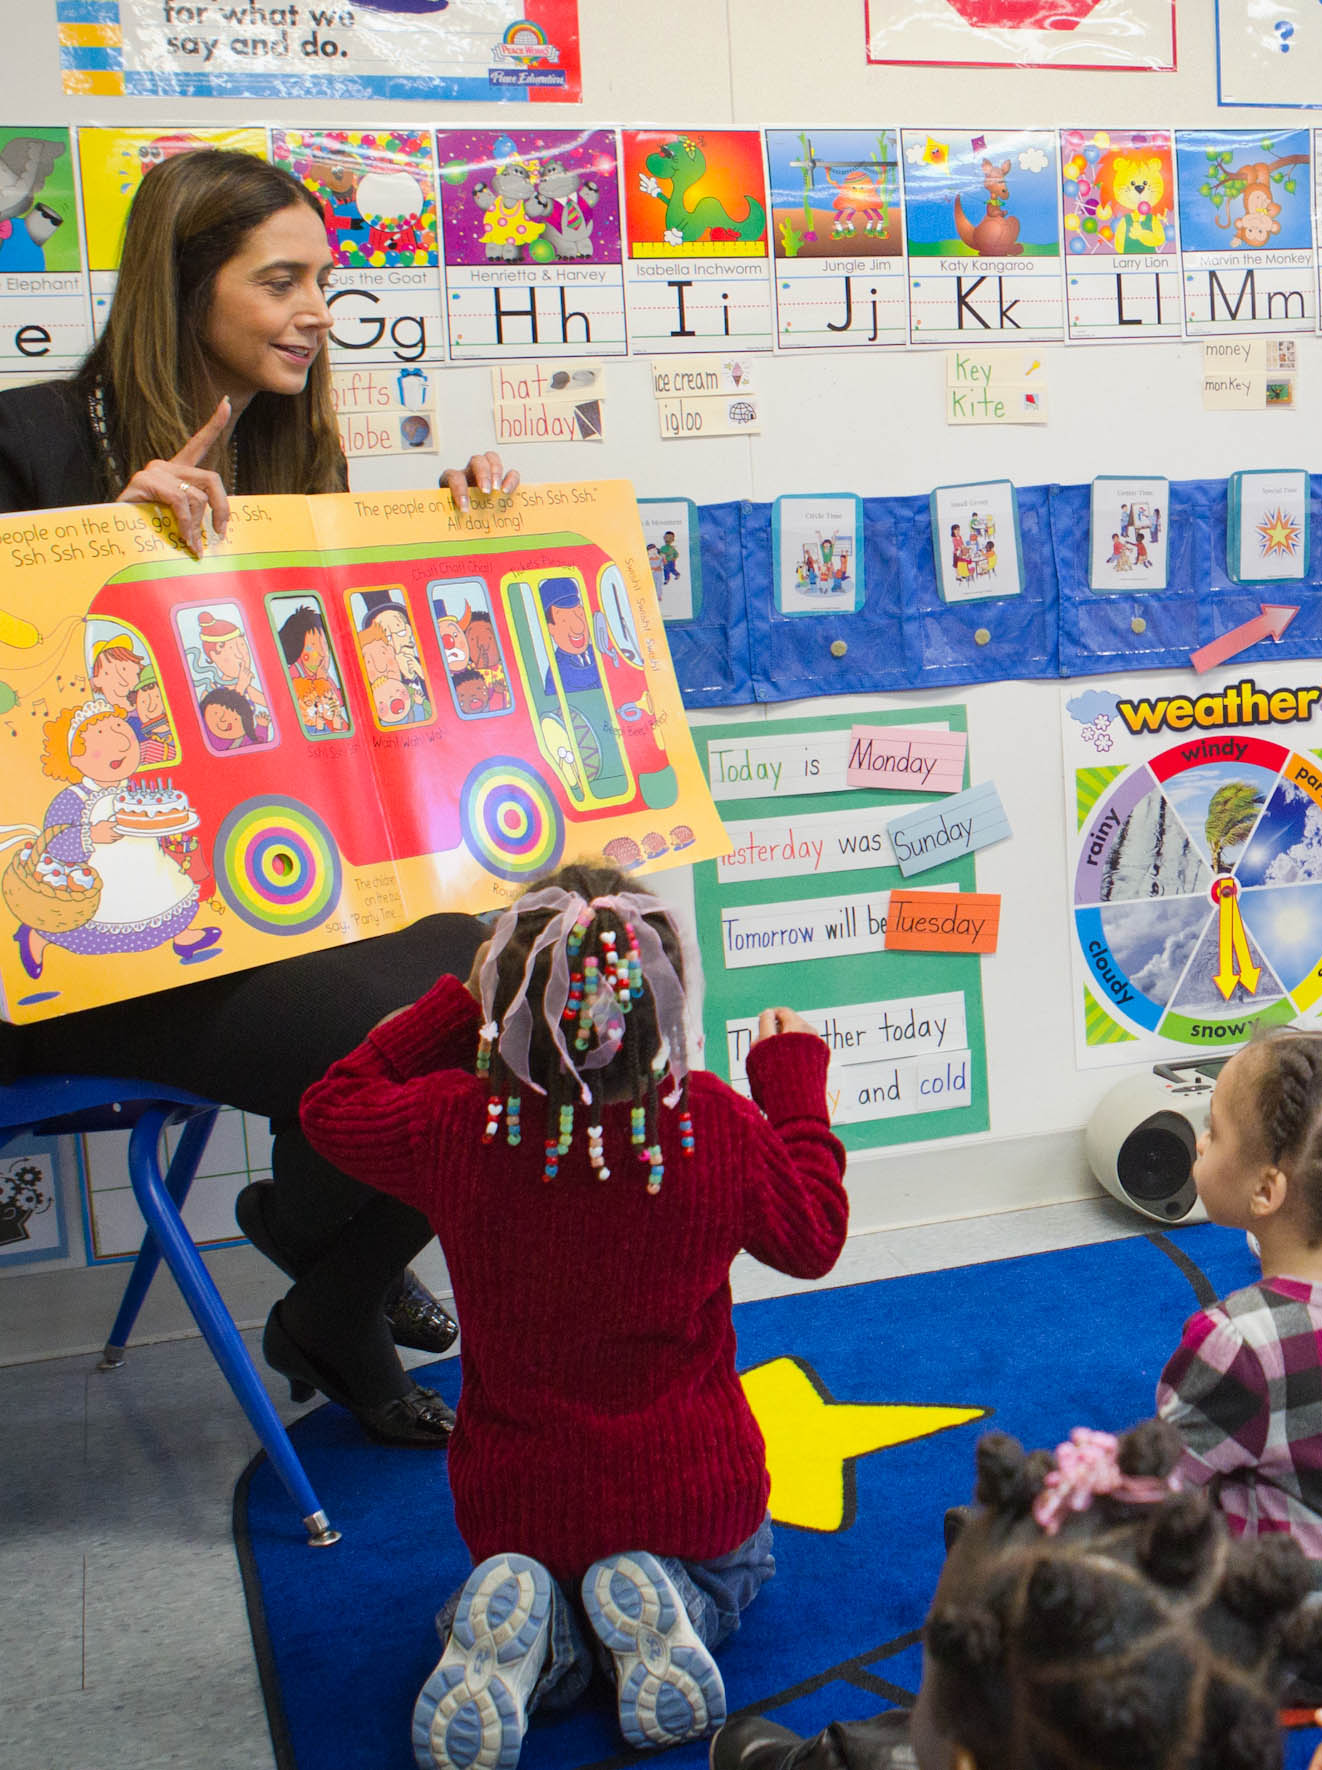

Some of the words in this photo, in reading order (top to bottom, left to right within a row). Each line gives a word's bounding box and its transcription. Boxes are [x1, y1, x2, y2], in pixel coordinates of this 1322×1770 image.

[163, 0, 208, 25] for
[219, 0, 298, 27] what
[308, 7, 356, 28] we
[167, 37, 219, 62] say
[229, 32, 289, 58] and
[300, 32, 349, 59] do.
[636, 263, 690, 276] Isabella
[693, 262, 762, 276] Inchworm
[822, 260, 866, 274] Jungle
[869, 259, 891, 272] Jim
[940, 260, 969, 274] Katy
[972, 259, 1034, 274] Kangaroo
[1113, 256, 1142, 271] Larry
[1145, 256, 1169, 269] Lion
[1242, 252, 1262, 266] the
[1265, 252, 1312, 267] Monkey
[6, 277, 80, 293] Elephant
[329, 272, 356, 286] Gus
[359, 271, 384, 285] the
[386, 271, 428, 285] Goat
[470, 268, 538, 282] Henrietta
[541, 269, 552, 281] &
[556, 269, 607, 284] Harvey
[1205, 343, 1251, 363] money
[499, 364, 549, 401] hat
[654, 365, 671, 393] ice
[673, 369, 719, 391] cream
[499, 402, 576, 440] holiday
[664, 399, 703, 436] igloo
[354, 501, 379, 518] The
[384, 499, 424, 520] people
[428, 500, 444, 512] on
[498, 496, 514, 512] go
[546, 488, 569, 505] Ssh
[55, 525, 78, 538] on
[81, 518, 110, 535] the
[113, 514, 146, 533] bus
[151, 516, 171, 533] go
[447, 515, 463, 532] All
[465, 515, 490, 533] day
[11, 547, 46, 568] Ssh
[50, 543, 85, 563] Ssh
[1116, 679, 1322, 735] weather
[710, 748, 783, 791] Today
[804, 746, 820, 777] is
[848, 737, 938, 785] Monday
[1181, 737, 1249, 763] windy
[838, 833, 882, 854] was
[893, 814, 973, 862] Sunday
[1086, 806, 1122, 867] rainy
[722, 918, 815, 951] Tomorrow
[825, 905, 857, 940] will
[867, 904, 887, 935] be
[890, 900, 986, 944] Tuesday
[1088, 940, 1135, 1006] cloudy
[879, 1007, 948, 1048] today
[858, 1068, 901, 1105] and
[920, 1061, 967, 1096] cold
